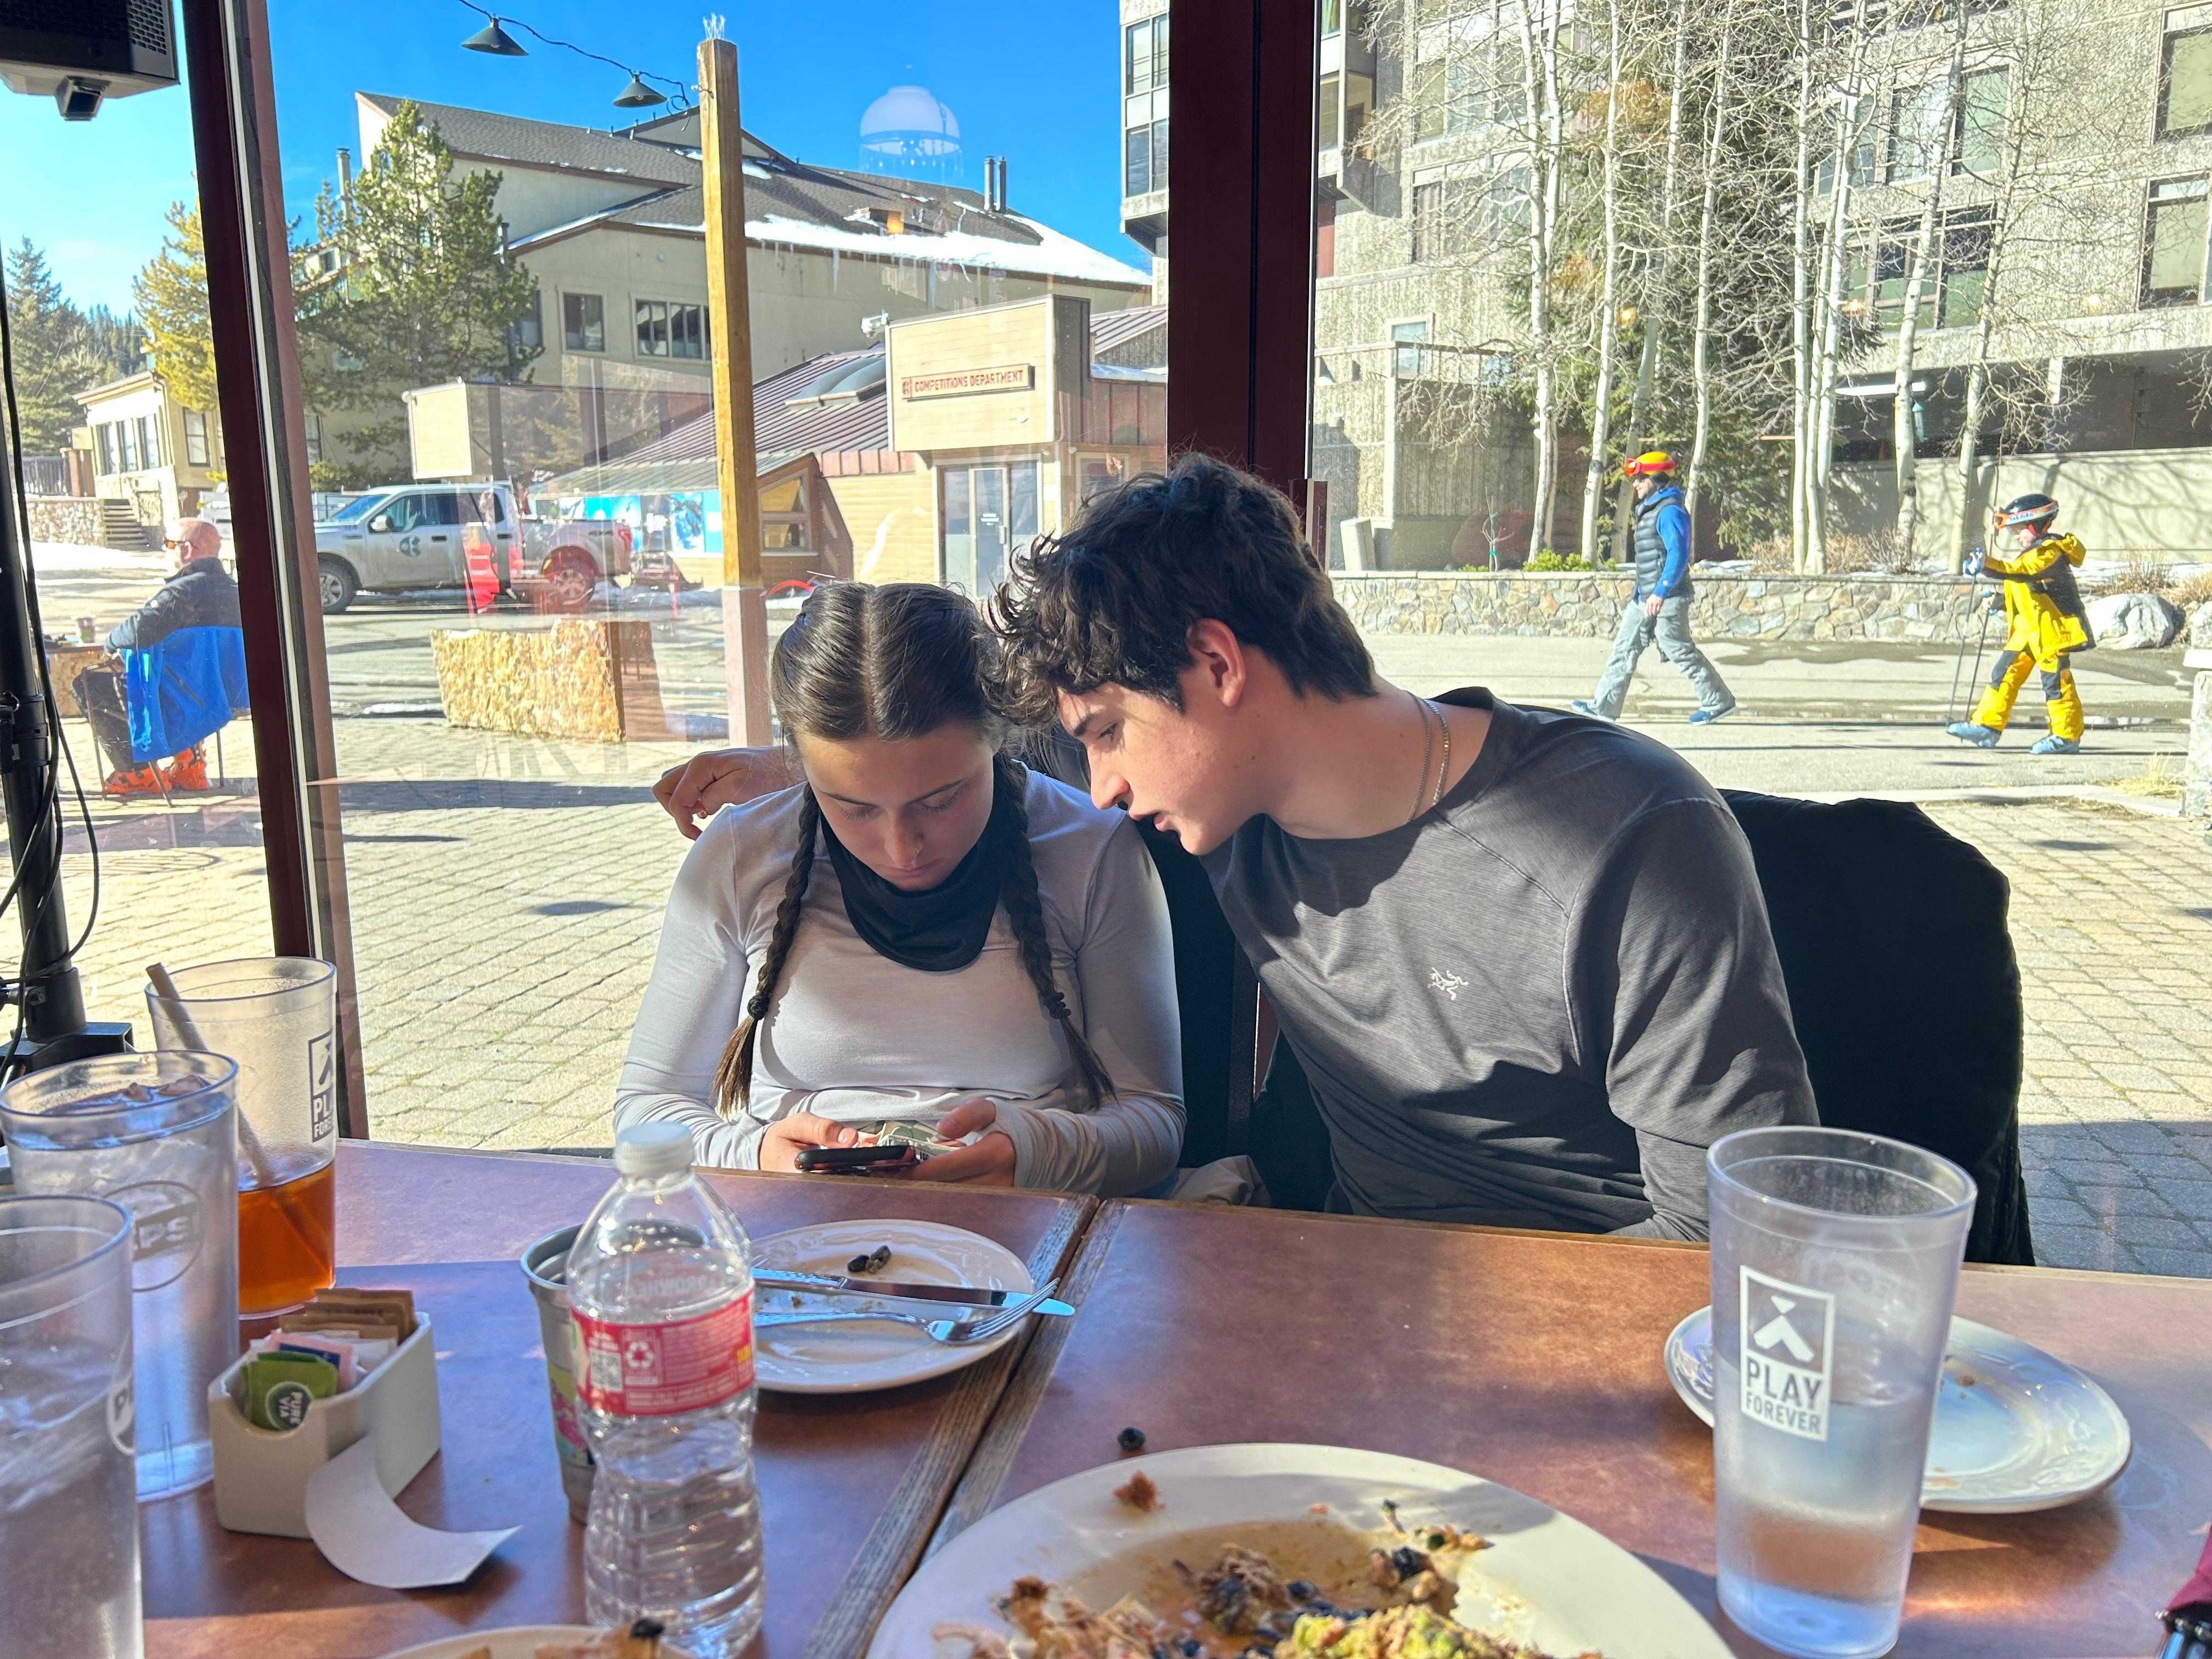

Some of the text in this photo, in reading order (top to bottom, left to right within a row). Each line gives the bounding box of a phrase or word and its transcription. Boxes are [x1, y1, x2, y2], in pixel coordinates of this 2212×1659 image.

[915, 370, 1023, 393] COMPETITIONS DEPARTMENT
[1746, 1355, 1823, 1410] PLAY
[1746, 1391, 1821, 1435] FOREVER
